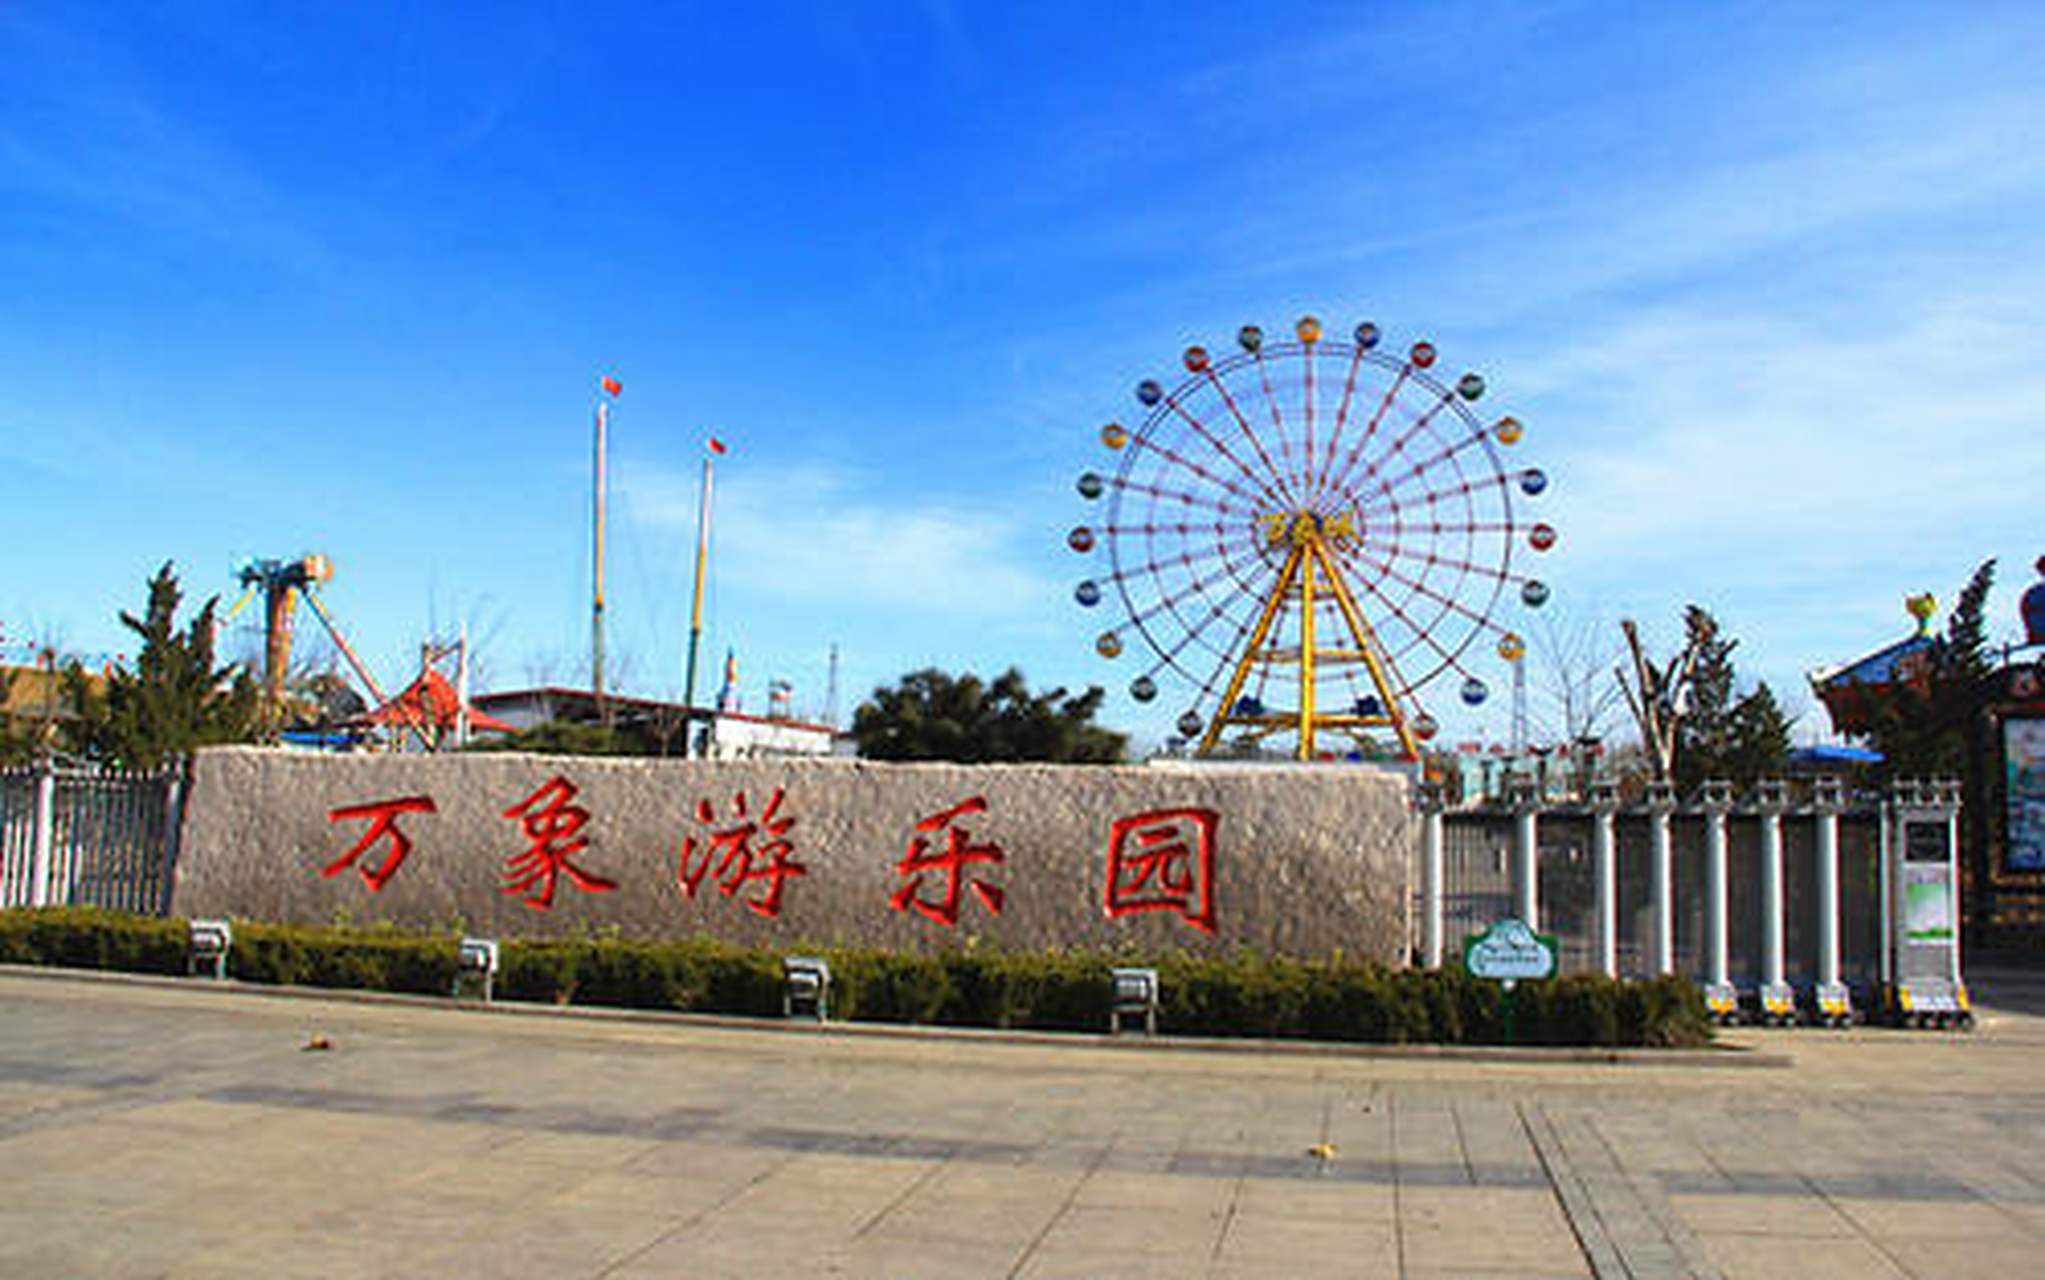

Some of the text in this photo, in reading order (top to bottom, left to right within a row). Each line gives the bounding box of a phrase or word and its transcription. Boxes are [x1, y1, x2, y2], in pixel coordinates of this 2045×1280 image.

[323, 775, 1220, 934] 万象游乐园
